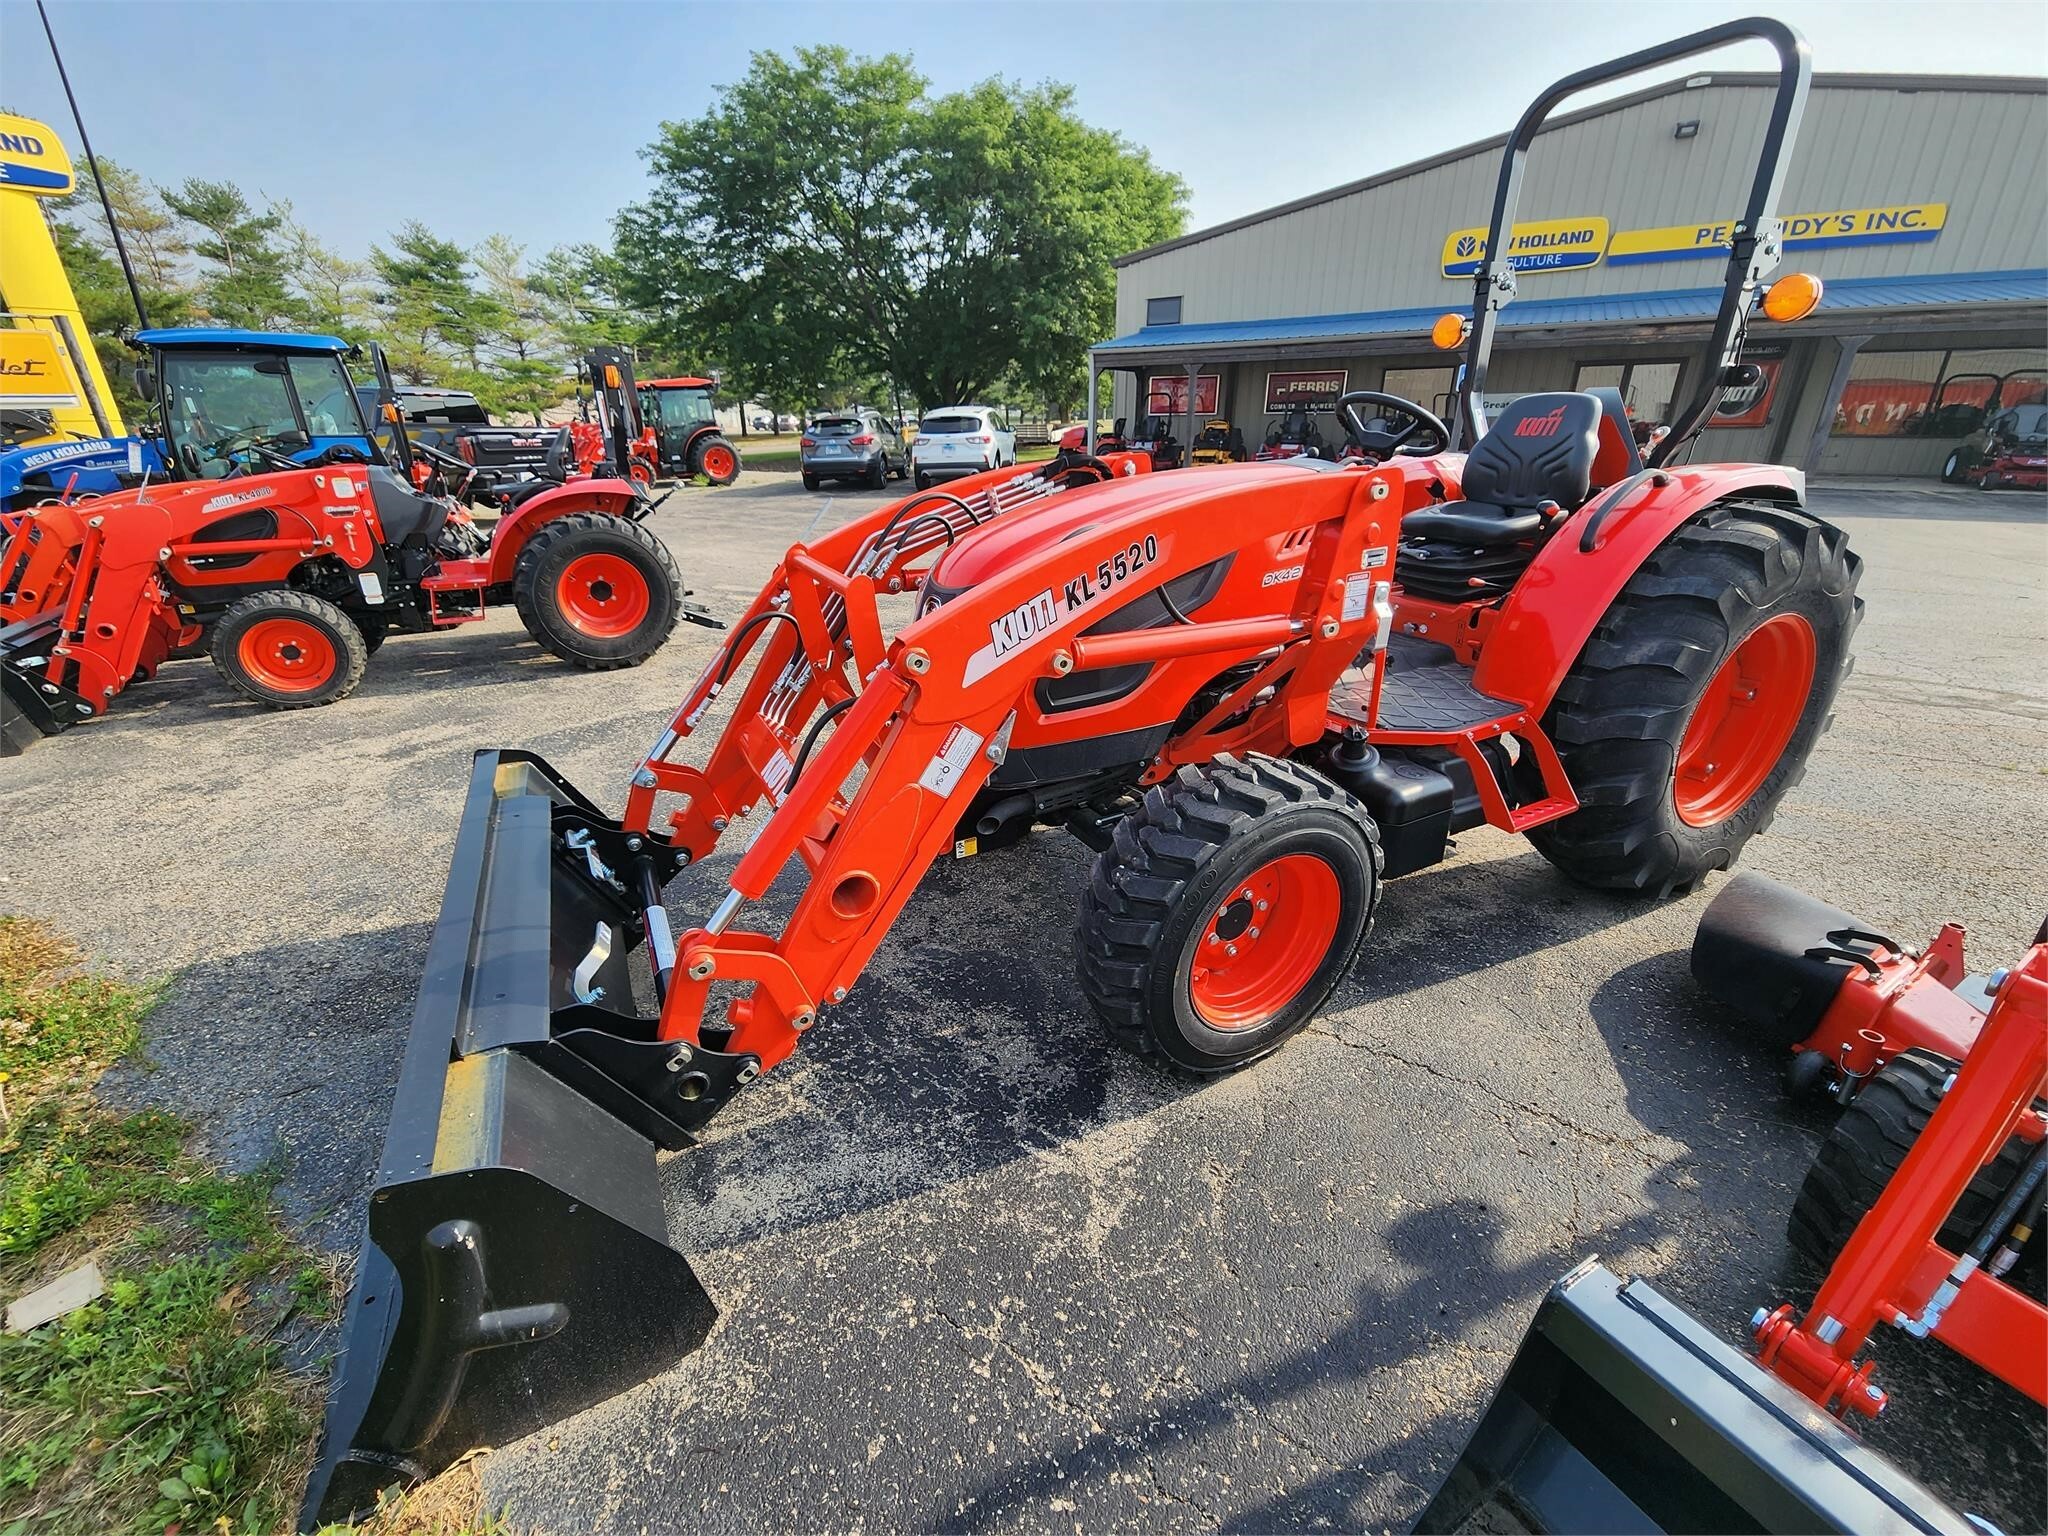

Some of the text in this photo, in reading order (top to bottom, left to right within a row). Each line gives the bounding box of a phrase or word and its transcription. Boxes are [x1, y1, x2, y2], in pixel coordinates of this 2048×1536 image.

[1865, 209, 1928, 231] INC.
[1518, 230, 1594, 249] HOLLAND
[1289, 380, 1340, 393] FERRIS
[1514, 412, 1565, 437] KIOTI
[22, 440, 112, 467] NEW HOLLAND
[512, 438, 543, 447] GMC
[989, 588, 1057, 658] KIOTI
[942, 726, 960, 751] DANGER
